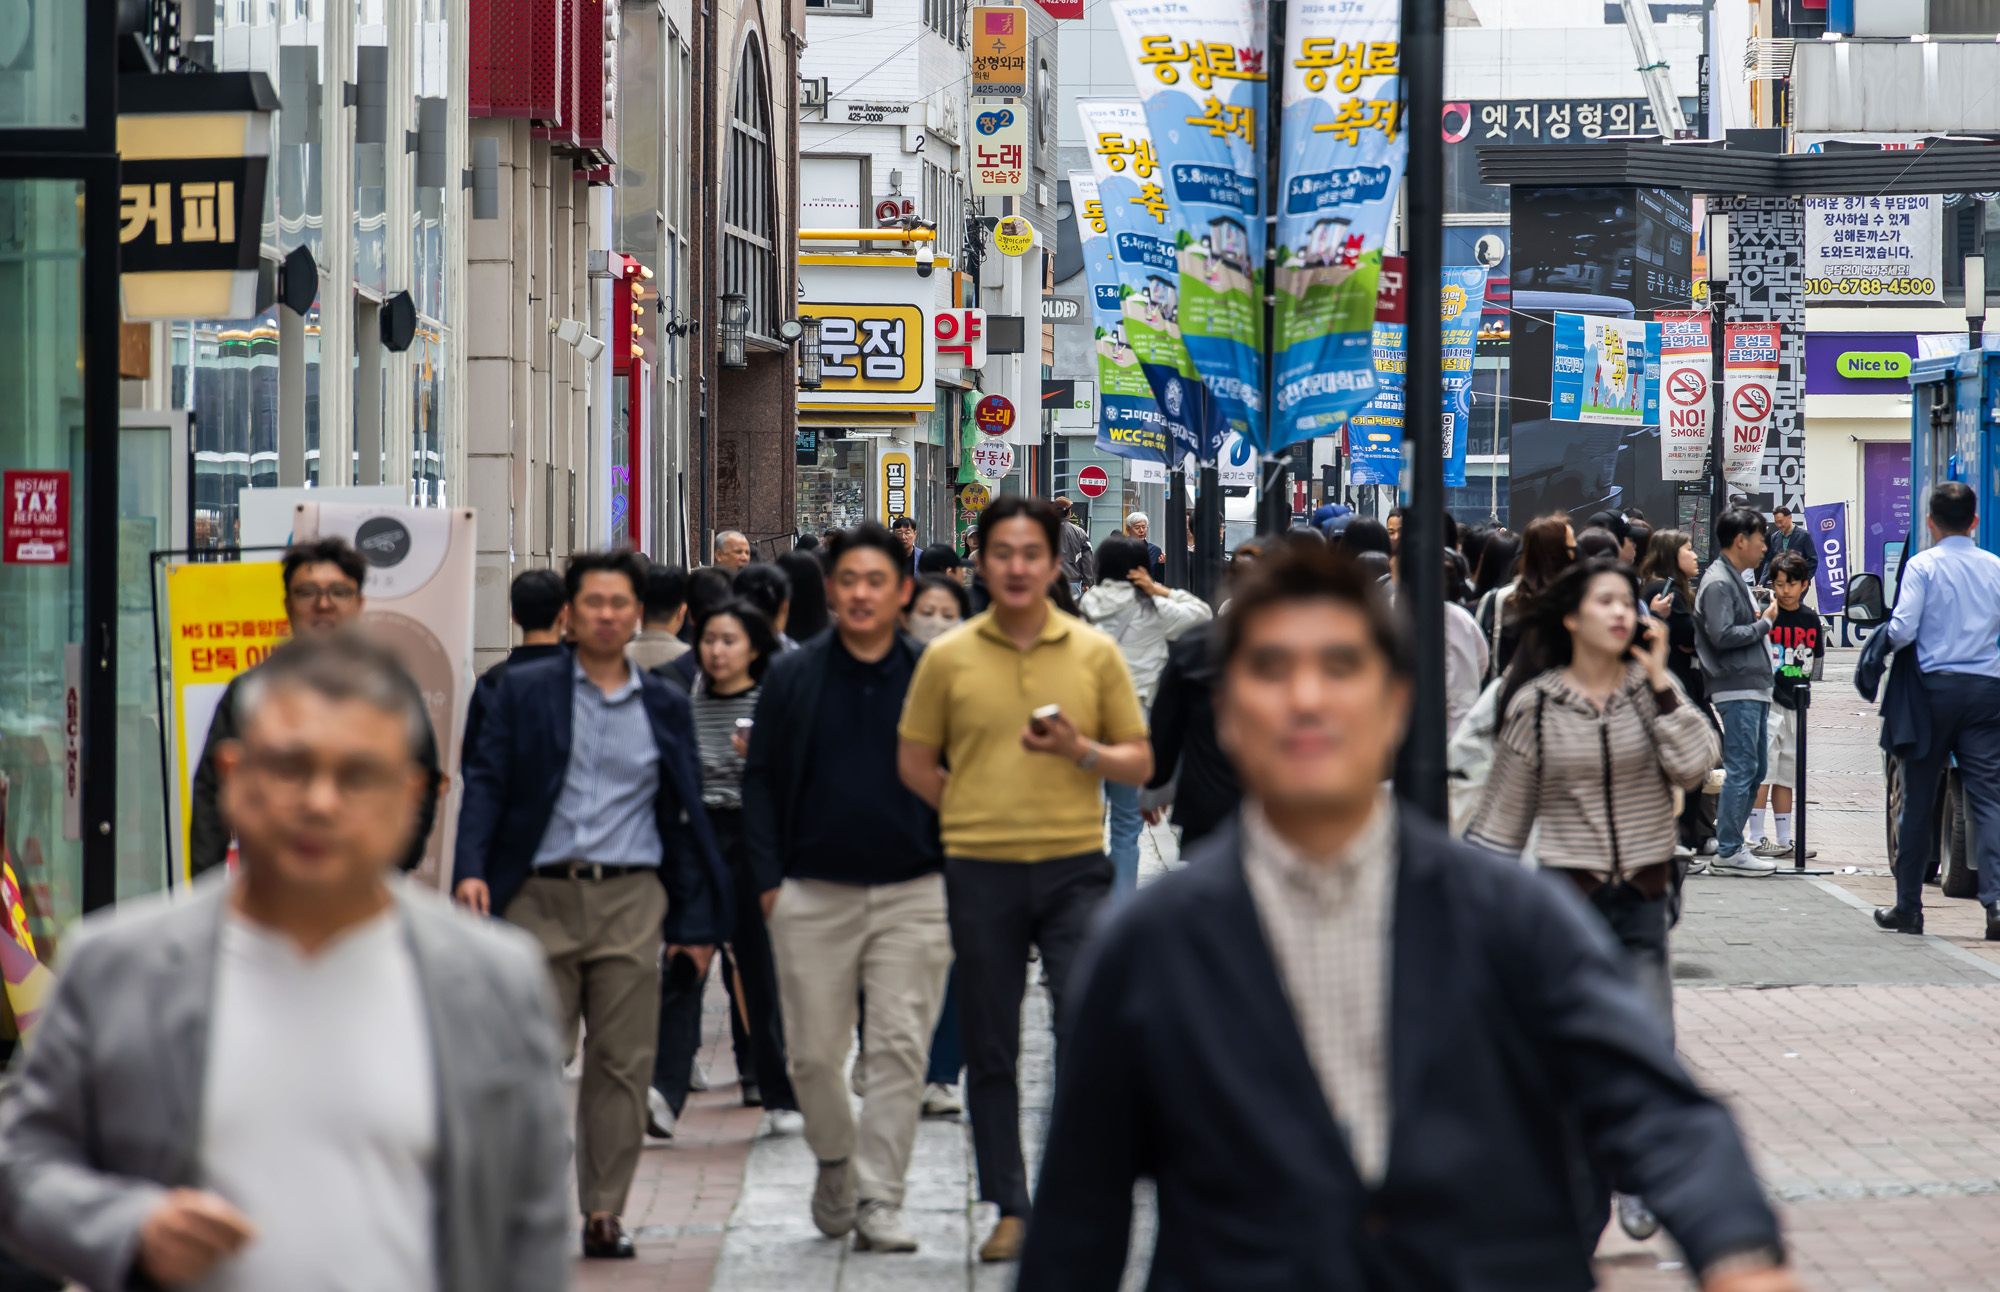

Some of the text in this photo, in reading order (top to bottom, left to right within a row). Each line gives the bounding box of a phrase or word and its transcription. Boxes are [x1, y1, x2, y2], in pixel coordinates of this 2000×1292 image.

[1164, 4, 1177, 13] 37
[1340, 2, 1354, 13] 37
[991, 38, 1007, 54] 수
[973, 56, 1026, 71] 성형외과
[1138, 34, 1268, 91] 동성로
[1293, 37, 1400, 93] 동성로
[974, 71, 990, 80] 의원
[976, 85, 1022, 94] 425-0009
[848, 113, 884, 122] 425-0009
[1000, 111, 1010, 126] 2
[1118, 108, 1129, 117] 37
[915, 135, 925, 152] 2
[976, 145, 1022, 169] 노래
[1095, 133, 1160, 179] 동성
[981, 170, 1022, 184] 연습장
[1806, 197, 1840, 210] 어려운
[1843, 196, 1866, 210] 경기
[1869, 197, 1881, 210] 속
[1884, 196, 1930, 210] 부담없이
[120, 181, 236, 245] 커피
[1824, 213, 1910, 226] 장사하실 수 있게
[1833, 229, 1901, 243] 심해돈까스가
[1820, 246, 1914, 259] 도와드리겠습니다.
[1824, 264, 1910, 276] 부담없이 전화주세요!
[1804, 277, 1936, 295] 010-6788-4500
[1665, 322, 1703, 334] 동성로
[935, 310, 981, 367] 약
[1661, 335, 1709, 349] 금연거리
[1735, 335, 1772, 347] 동성로
[1728, 349, 1777, 362] 금연거리
[1848, 358, 1899, 371] Nice to
[980, 407, 1011, 425] 노래
[1669, 409, 1706, 428] NO!
[1109, 427, 1142, 442] WCC
[1670, 428, 1705, 438] SMOKE
[1734, 425, 1767, 443] NO!
[1733, 444, 1762, 454] SMOKE
[974, 449, 1012, 467] 부동산
[986, 467, 998, 477] 3F
[14, 491, 58, 511] TAX
[190, 646, 238, 673] 단독
[66, 686, 79, 799] ABC-MART
